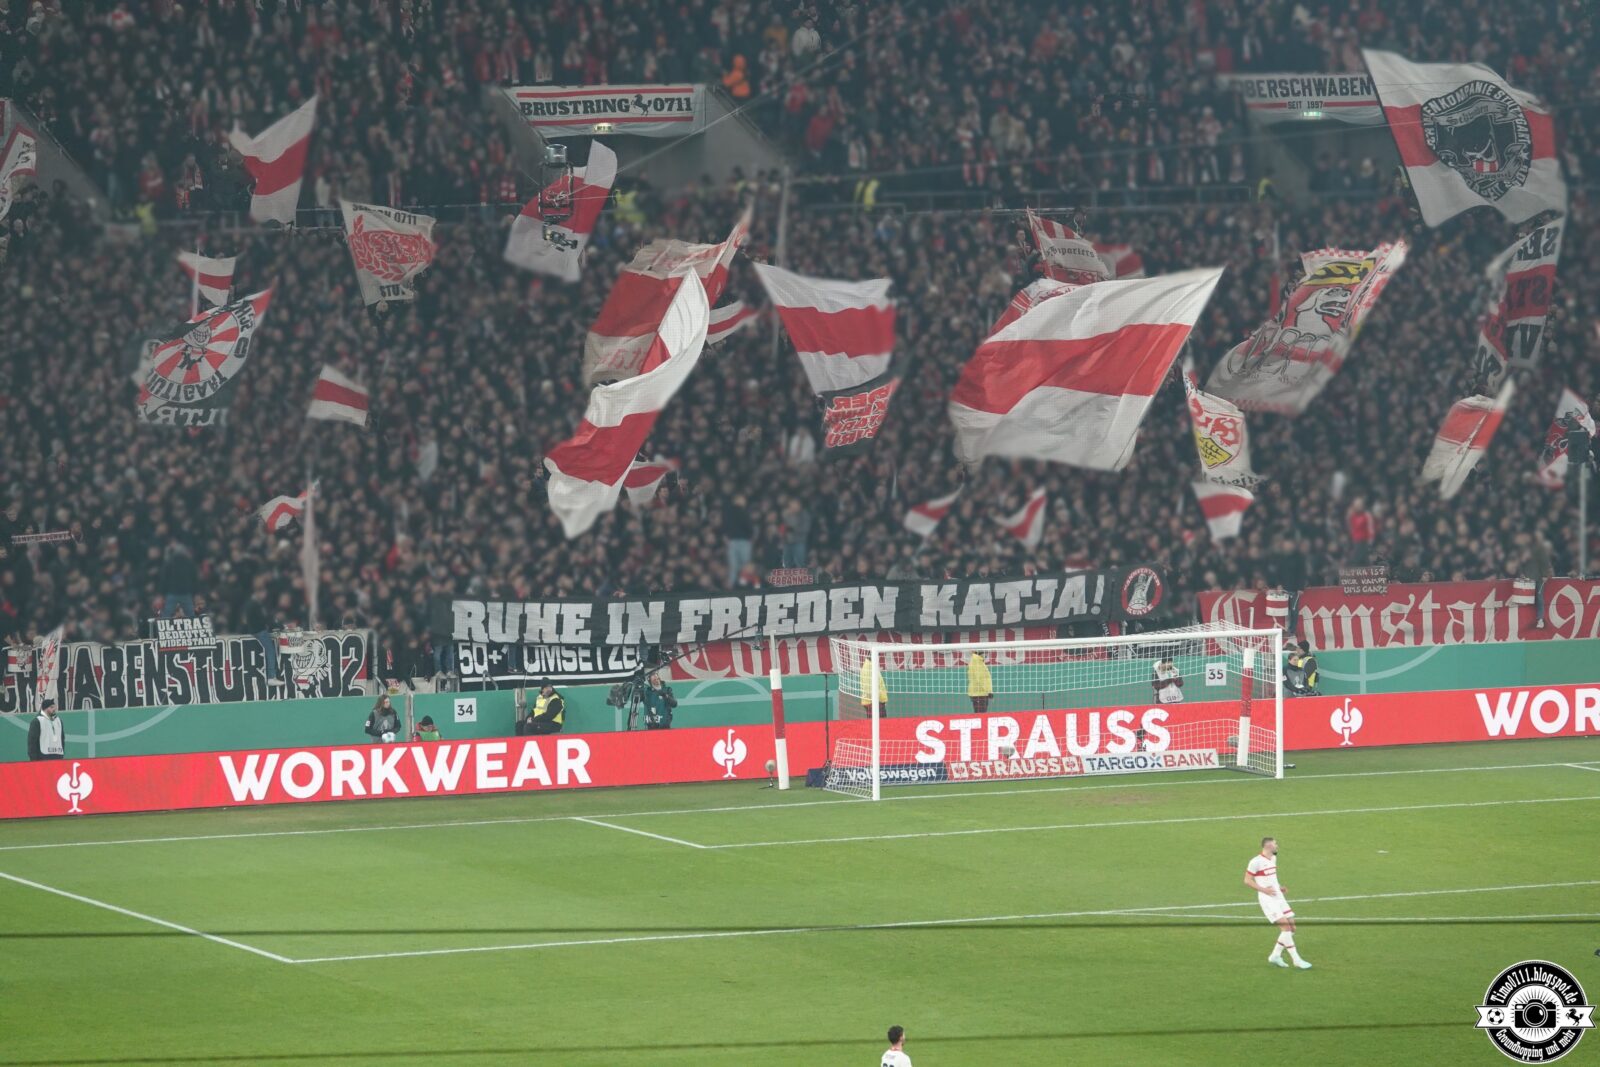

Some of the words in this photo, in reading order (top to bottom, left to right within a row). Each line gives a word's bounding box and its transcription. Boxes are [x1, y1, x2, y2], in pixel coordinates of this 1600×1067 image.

[520, 98, 630, 116] BRUSTRING
[653, 97, 692, 112] 0711
[1287, 101, 1302, 109] SEIT
[394, 211, 417, 225] 0711
[451, 599, 592, 644] RUHE
[605, 600, 665, 645] IN
[677, 586, 899, 645] FRIEDEN
[919, 574, 1105, 627] KATJA!
[157, 616, 212, 632] ULTRAS
[158, 629, 213, 640] BEDEUTET
[160, 638, 217, 648] WIDERSTAND
[458, 642, 508, 675] 50+
[1208, 668, 1225, 680] 35
[456, 704, 474, 717] 34
[915, 708, 1171, 764] STRAUSS
[219, 738, 592, 801] WORKWEAR
[846, 767, 936, 782] Volswagen
[971, 758, 1060, 778] STRAUSS
